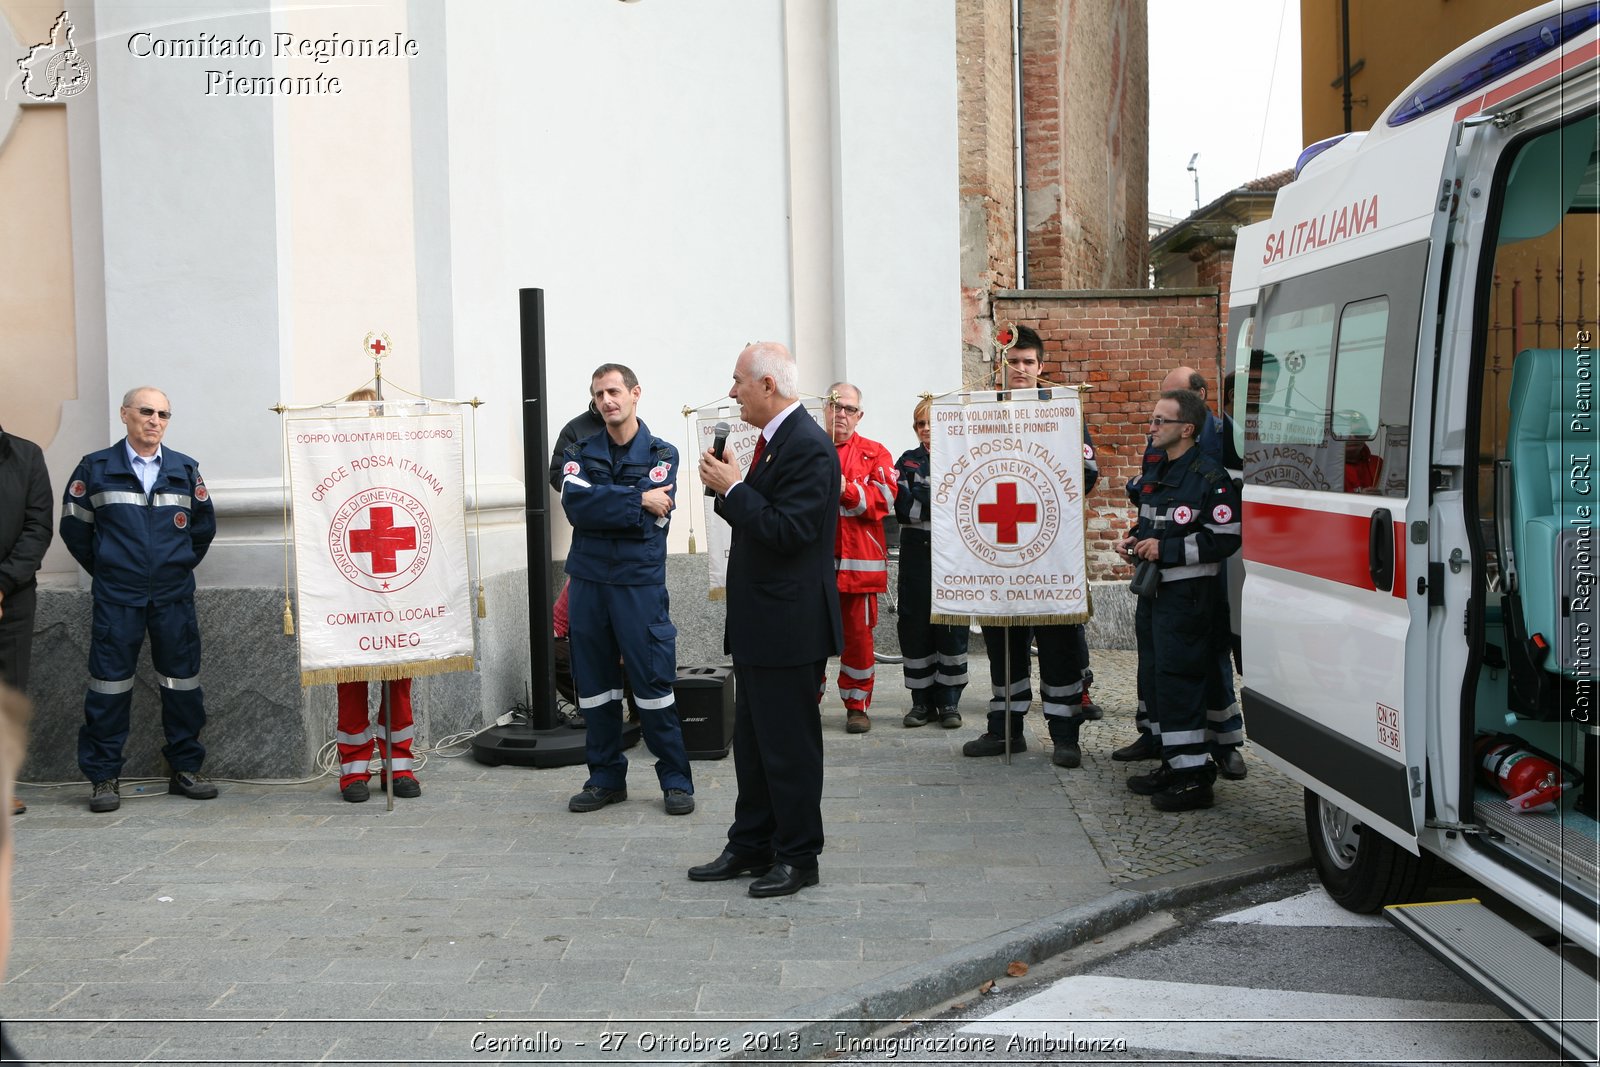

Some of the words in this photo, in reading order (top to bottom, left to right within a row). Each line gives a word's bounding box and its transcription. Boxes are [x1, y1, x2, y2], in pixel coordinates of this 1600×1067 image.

[1263, 229, 1285, 265] SA
[1288, 194, 1378, 257] ITALIANA
[966, 409, 1011, 420] VOLONTARI
[1014, 408, 1031, 419] DEL
[1034, 407, 1075, 418] SOCCORSO
[296, 434, 330, 444] CORPO
[332, 432, 385, 443] VOLONTARI
[386, 431, 403, 440] DEL
[404, 429, 453, 440] SOCCORSO
[947, 425, 964, 436] SEZ
[967, 423, 1013, 435] FEMMINILE
[1015, 423, 1021, 433] E
[1023, 422, 1059, 433] PIONIERI
[311, 466, 349, 502] CROCE
[350, 455, 394, 472] ROSSA
[399, 458, 444, 497] ITALIANA
[936, 455, 970, 504] CROCE
[969, 438, 1023, 461] ROSSA
[1027, 442, 1079, 503] ITALIANA
[972, 471, 985, 485] DI
[987, 462, 1039, 482] GINEVRA
[359, 490, 405, 505] GINEVRA
[1037, 481, 1051, 496] 22
[348, 499, 360, 511] DI
[405, 499, 419, 513] 22
[959, 487, 997, 562] CONVENZIONE
[1041, 499, 1057, 541] AGOSTO
[416, 511, 430, 554] AGOSTO
[331, 508, 359, 580] CONVENZIONE
[1019, 540, 1045, 562] 1864
[410, 555, 426, 576] 1864
[943, 575, 1005, 586] COMITATO
[1009, 574, 1058, 586] LOCALE
[1062, 574, 1075, 584] DI
[936, 588, 985, 601] BORGO
[990, 589, 1001, 602] S.
[1006, 588, 1082, 601] DALMAZZO
[326, 610, 394, 626] COMITATO
[399, 606, 446, 621] LOCALE
[359, 632, 421, 651] CUNEO
[1377, 706, 1387, 723] CN
[1389, 711, 1397, 728] 12
